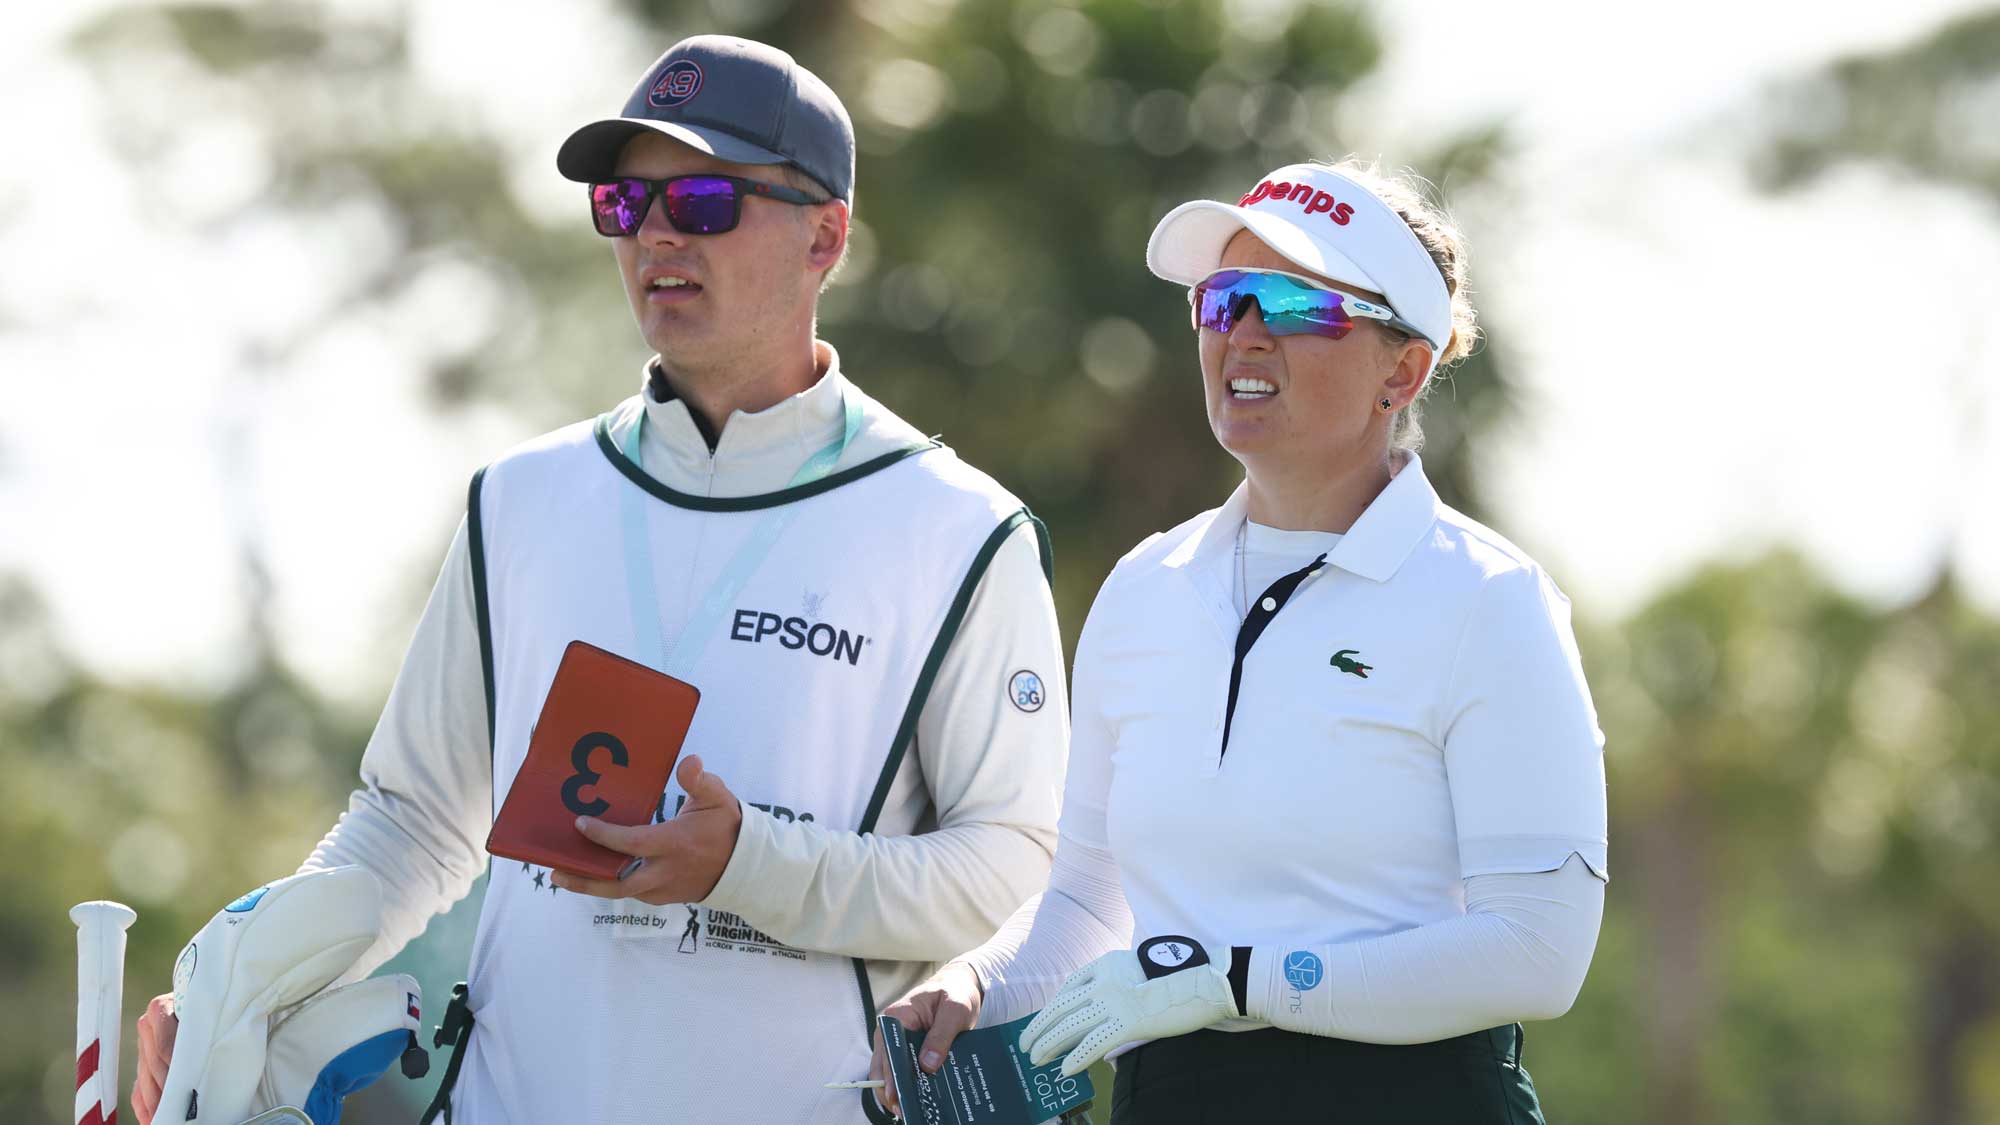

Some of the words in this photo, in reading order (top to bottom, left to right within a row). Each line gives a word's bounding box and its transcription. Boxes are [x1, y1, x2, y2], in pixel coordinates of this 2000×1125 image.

[652, 70, 698, 98] 49
[730, 608, 865, 666] EPSON
[593, 914, 650, 926] presented
[652, 916, 667, 929] by
[708, 909, 753, 928] UNIT
[707, 924, 752, 941] VIRGIN
[953, 1066, 964, 1090] Country
[977, 1067, 988, 1091] February
[1033, 1073, 1058, 1111] GOLF
[960, 1090, 975, 1122] Bradenton
